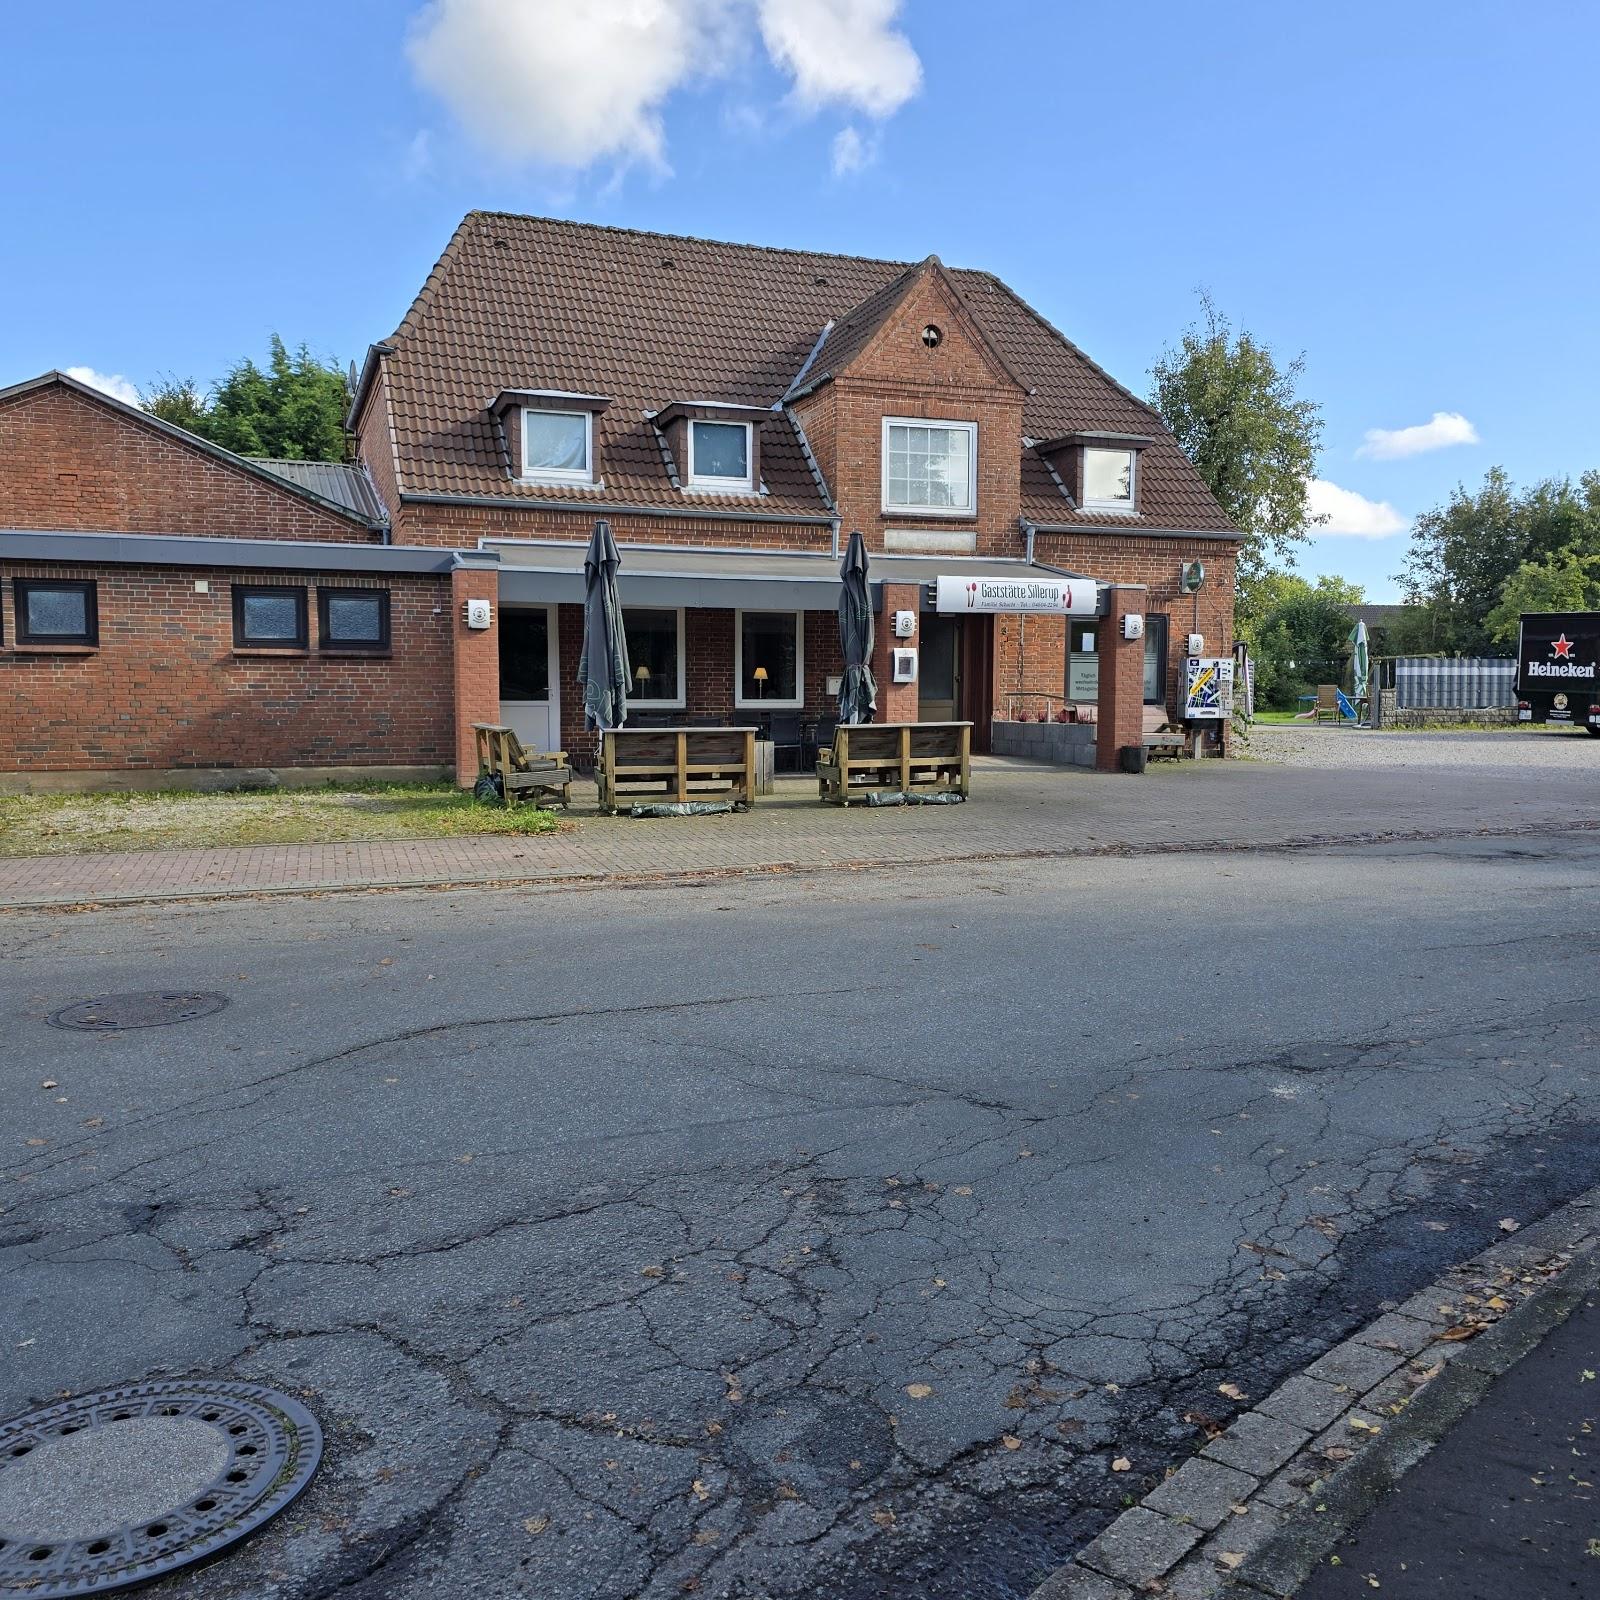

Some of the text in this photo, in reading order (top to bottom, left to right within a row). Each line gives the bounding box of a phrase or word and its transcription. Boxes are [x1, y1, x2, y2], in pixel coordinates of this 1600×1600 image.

[981, 583, 1059, 602] Gaststätte Sillerup
[1528, 661, 1595, 678] Heineken
